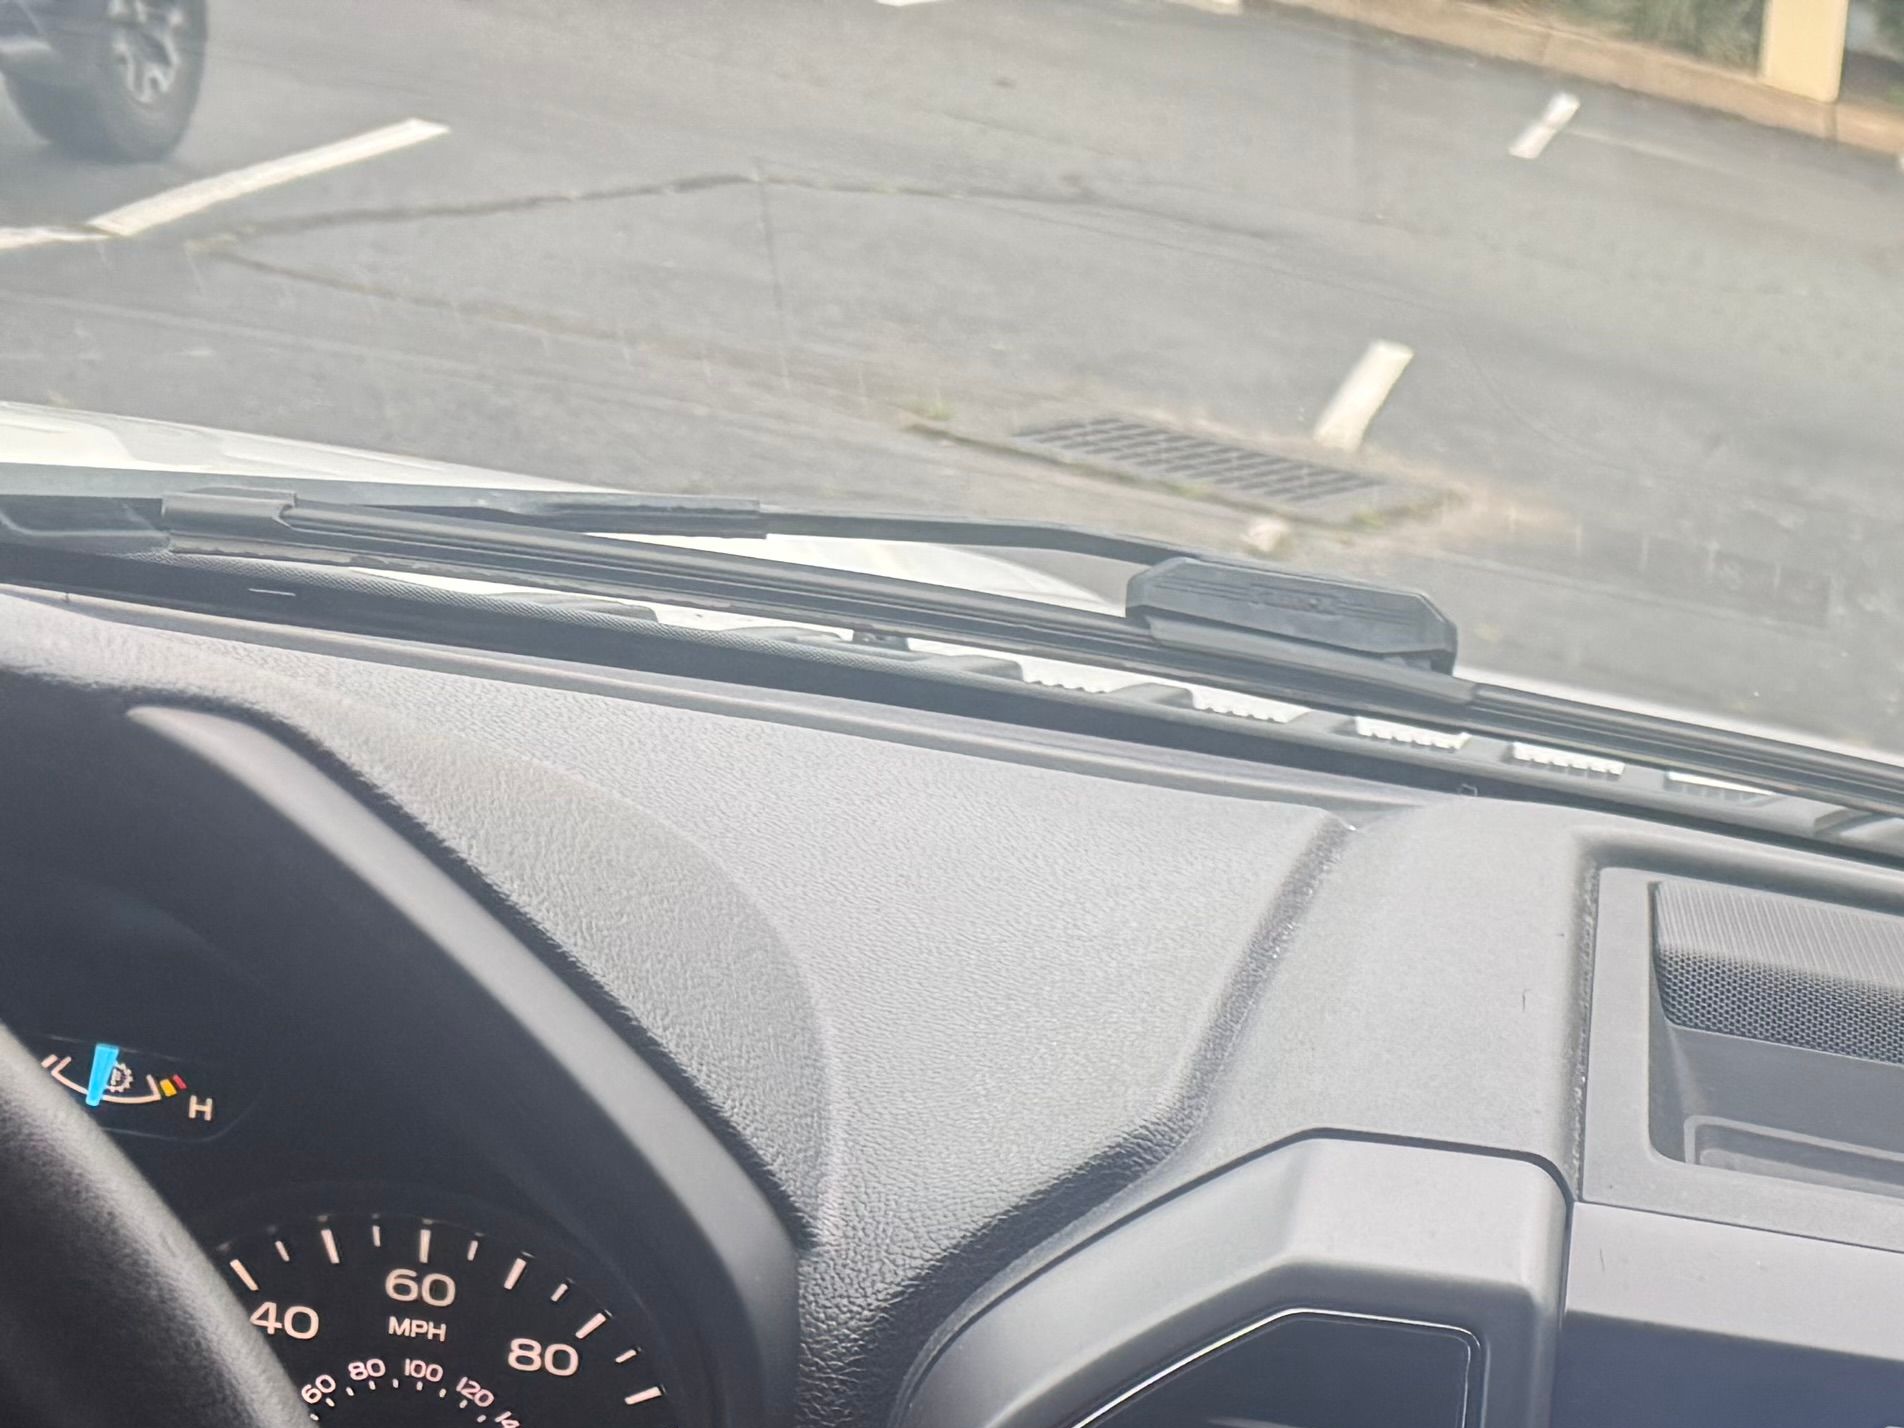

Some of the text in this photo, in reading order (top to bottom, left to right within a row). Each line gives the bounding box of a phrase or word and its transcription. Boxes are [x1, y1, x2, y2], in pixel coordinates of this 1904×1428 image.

[188, 1095, 213, 1121] H
[385, 1268, 456, 1307] 60
[250, 1301, 319, 1340] 40
[388, 1316, 447, 1342] MPH
[348, 1358, 386, 1381] 80
[404, 1358, 444, 1382] 100
[507, 1337, 579, 1377] 80
[301, 1374, 336, 1404] 60
[455, 1376, 495, 1407] 120
